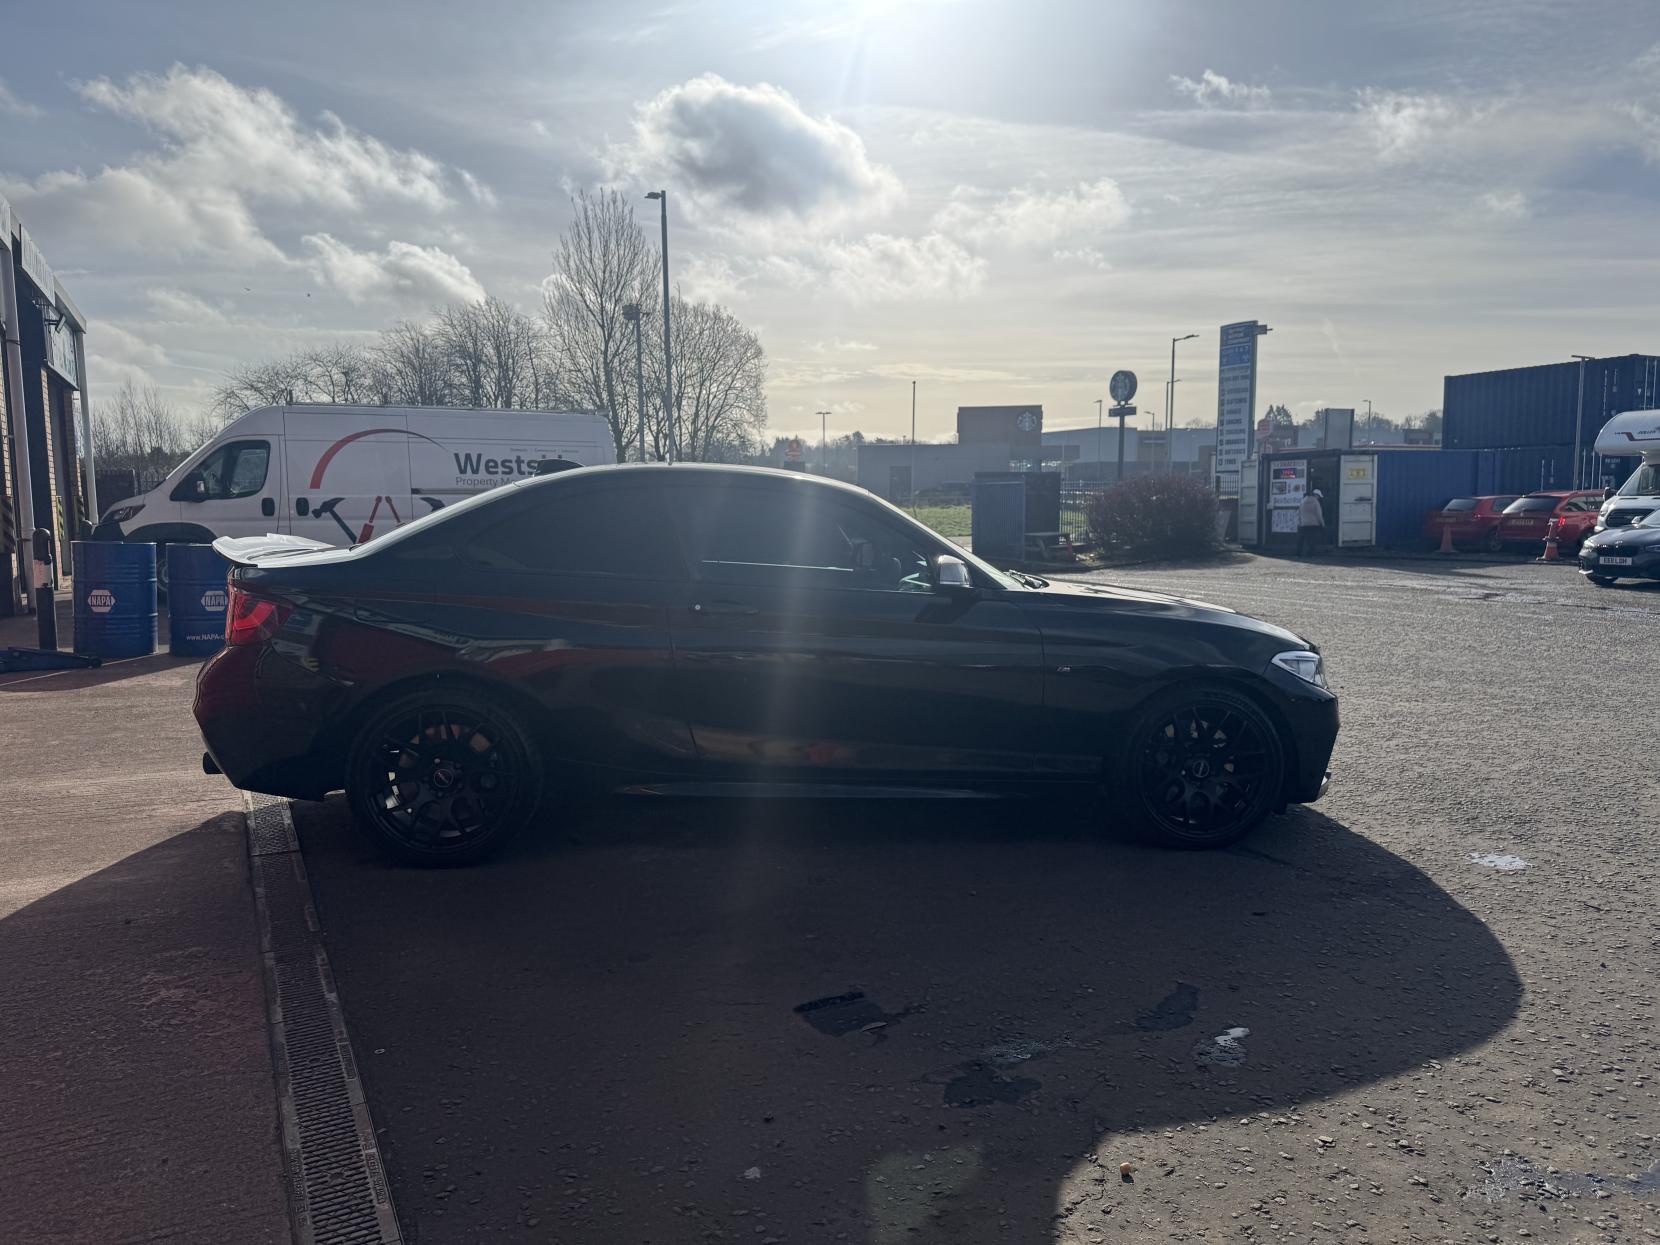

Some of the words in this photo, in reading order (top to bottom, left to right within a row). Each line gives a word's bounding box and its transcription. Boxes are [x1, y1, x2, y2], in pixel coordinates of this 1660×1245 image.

[453, 453, 562, 475] Wests
[455, 477, 498, 488] Property
[91, 595, 111, 606] NAPA
[205, 595, 225, 606] NAPA
